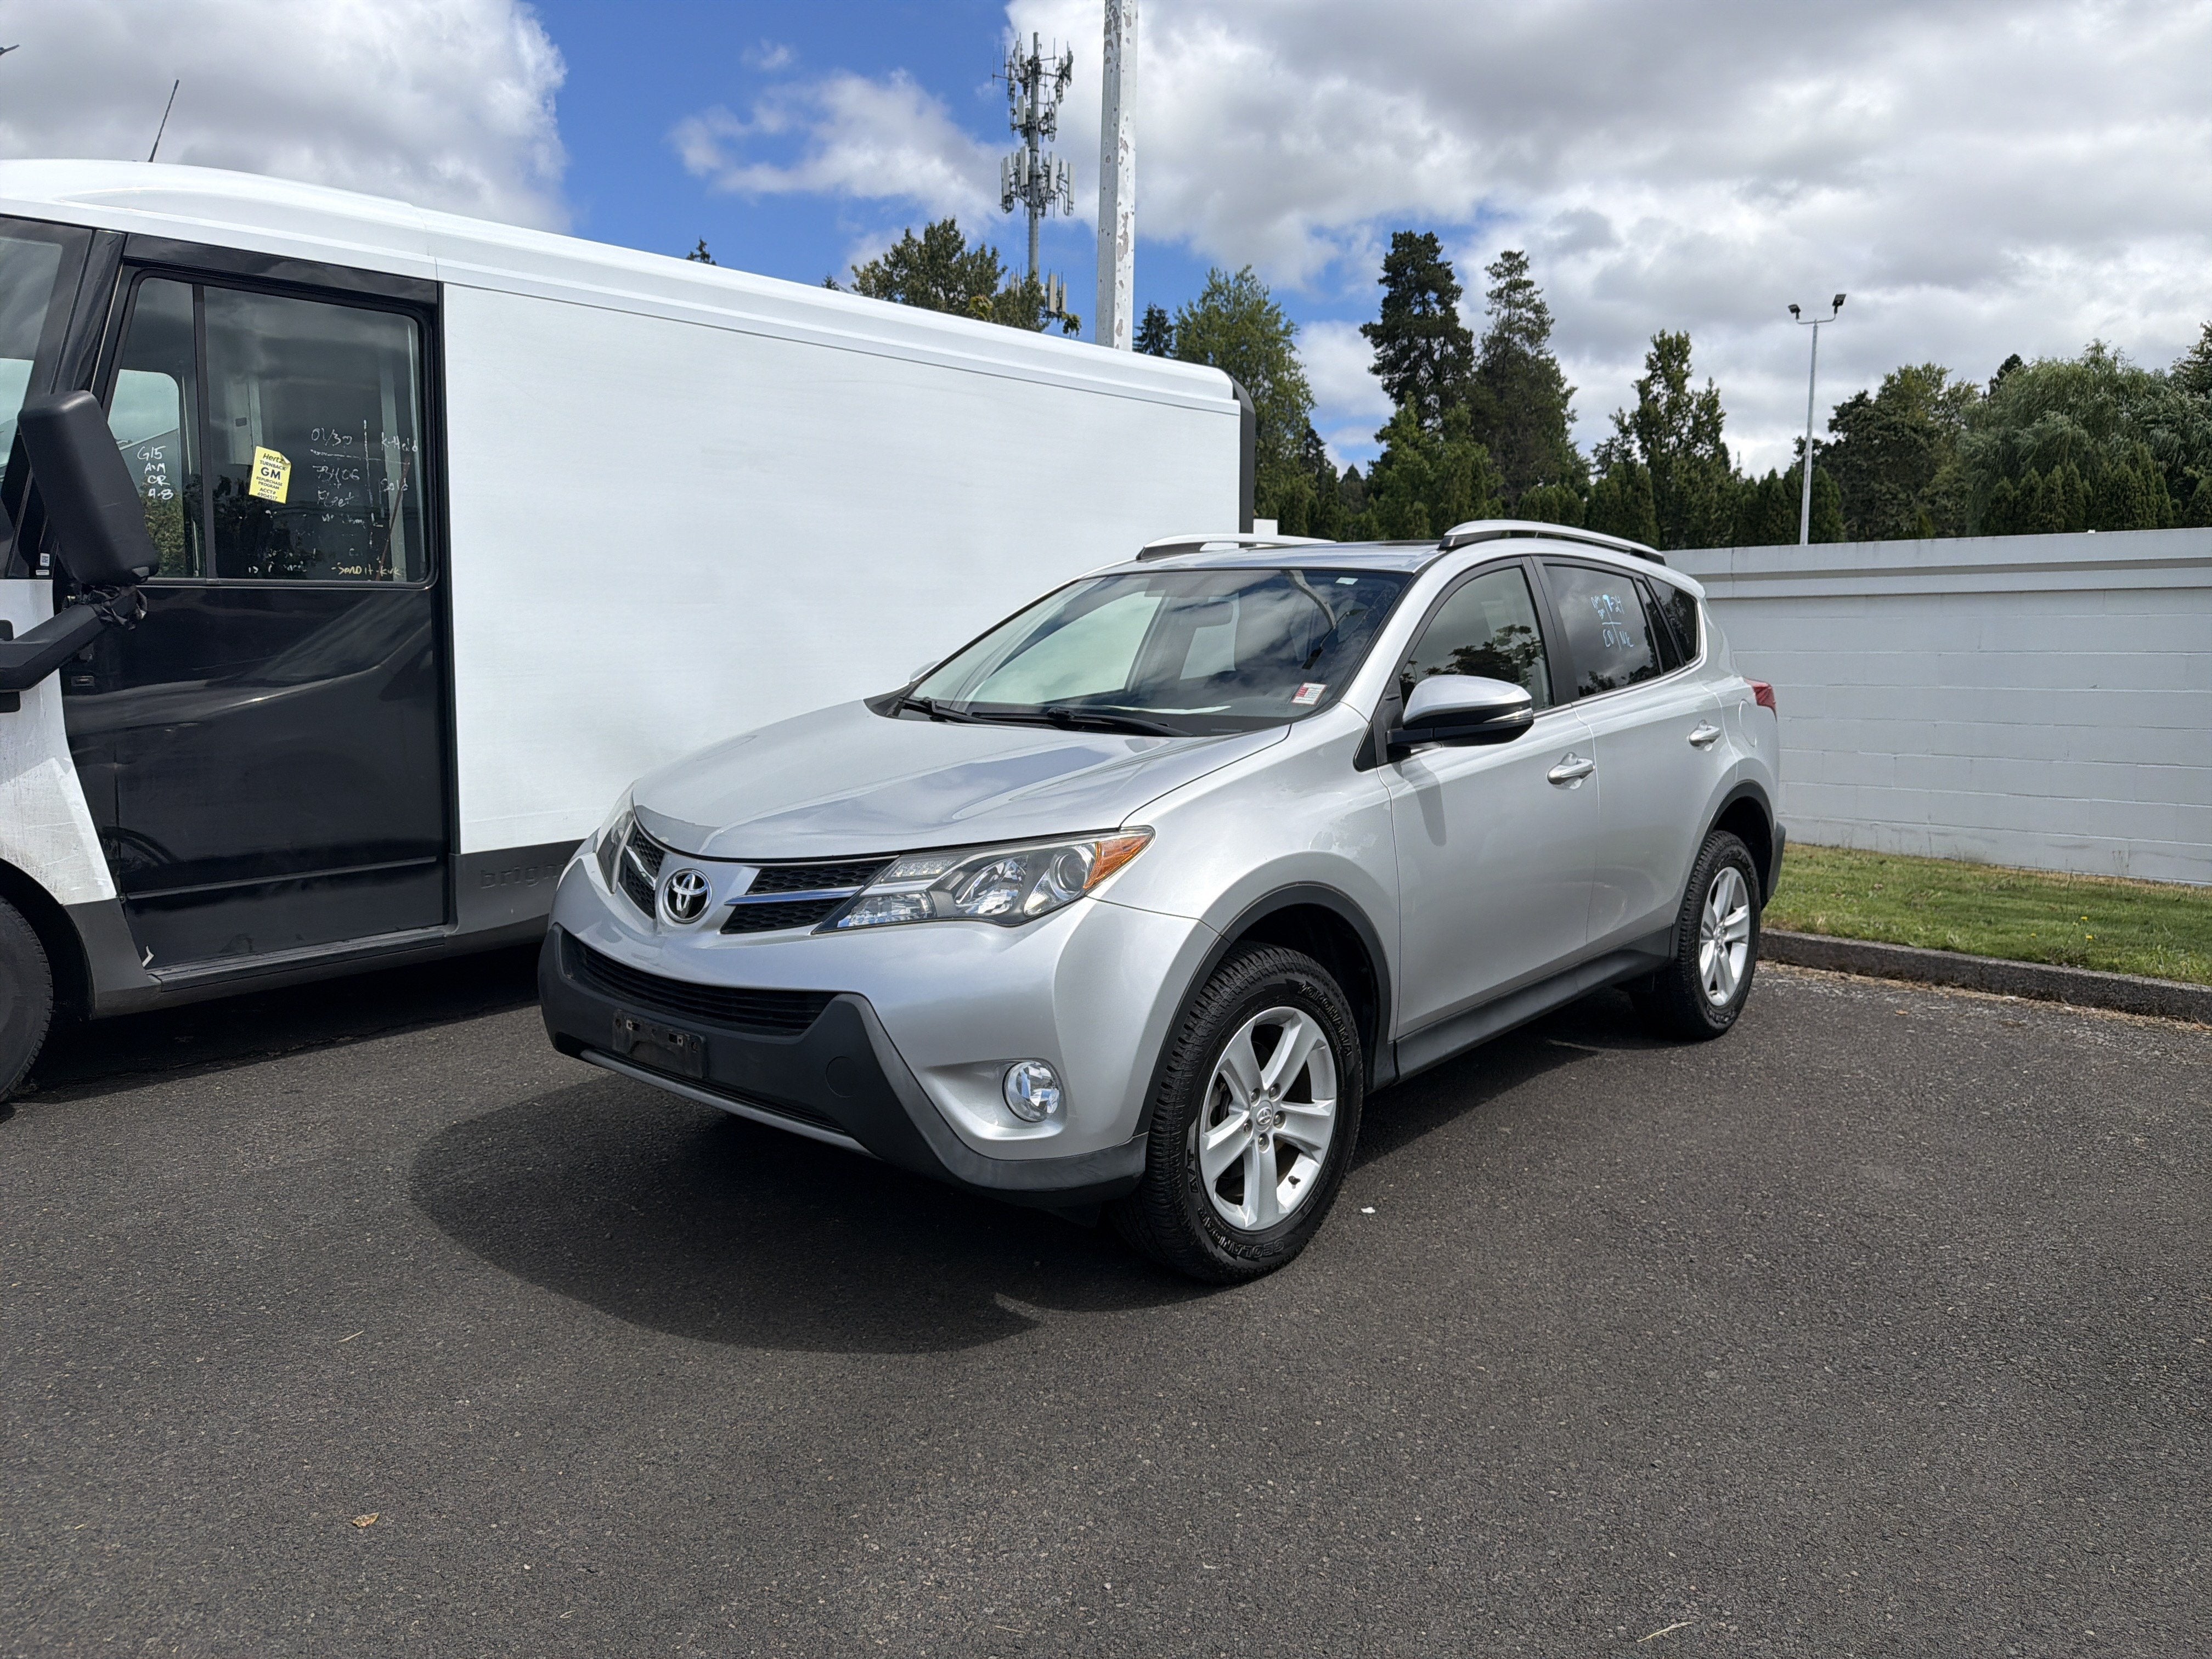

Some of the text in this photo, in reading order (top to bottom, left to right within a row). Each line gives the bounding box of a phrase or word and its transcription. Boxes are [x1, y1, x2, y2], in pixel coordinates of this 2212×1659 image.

[262, 453, 285, 464] Hertz
[259, 460, 286, 471] TURNBACK
[261, 466, 281, 480] GM
[256, 476, 283, 487] REPURCHASE
[258, 481, 280, 490] PROGRAM
[257, 492, 278, 500] 4904517
